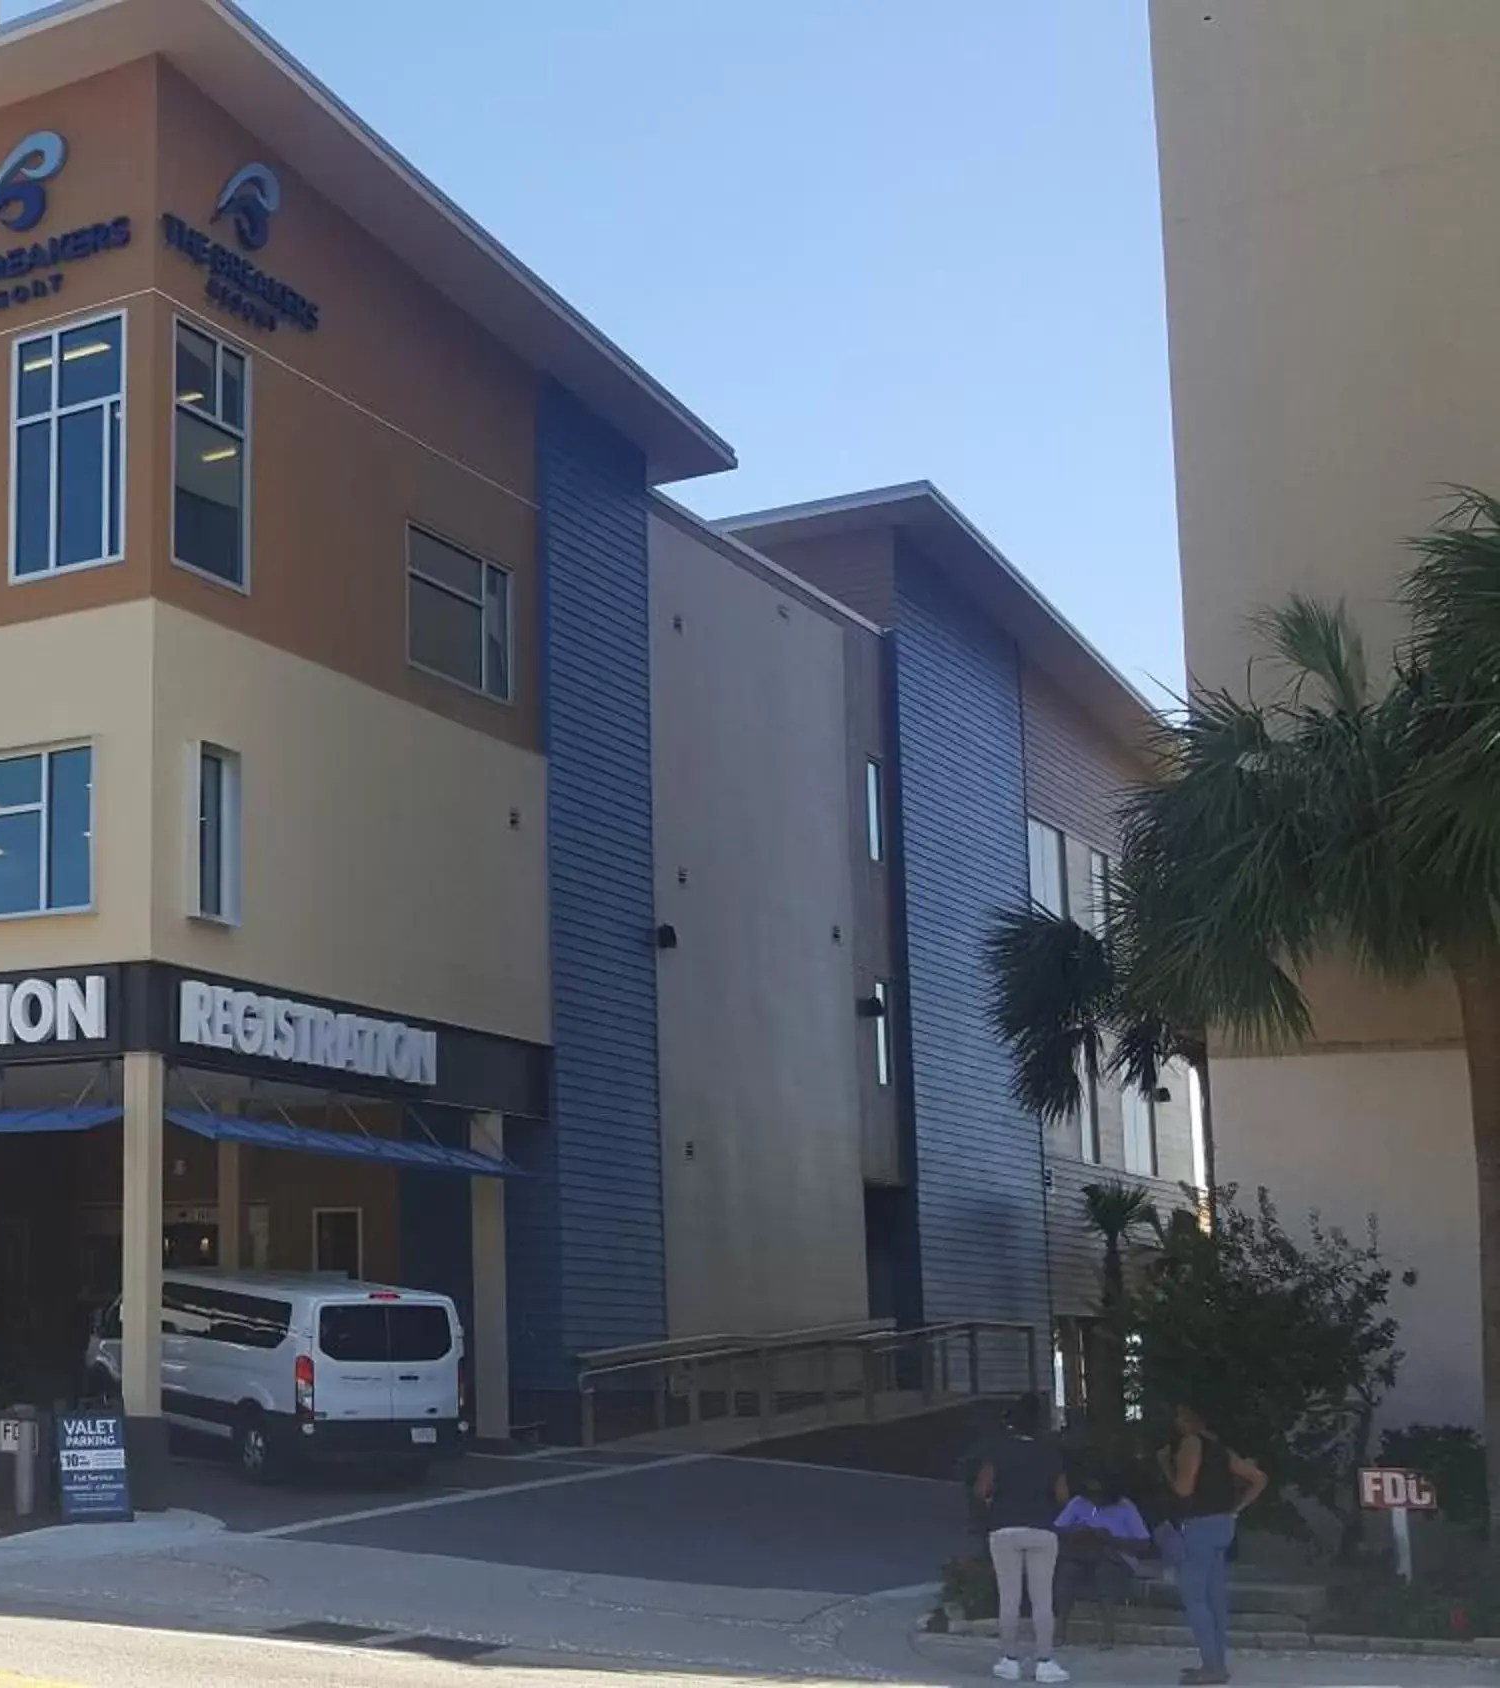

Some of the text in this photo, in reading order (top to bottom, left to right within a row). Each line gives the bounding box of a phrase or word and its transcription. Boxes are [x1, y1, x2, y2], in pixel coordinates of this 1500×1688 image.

[162, 213, 319, 332] THE BREAKERS
[179, 979, 438, 1085] REGISTRATION
[63, 1418, 117, 1435] VALET
[65, 1435, 116, 1447] PARKING
